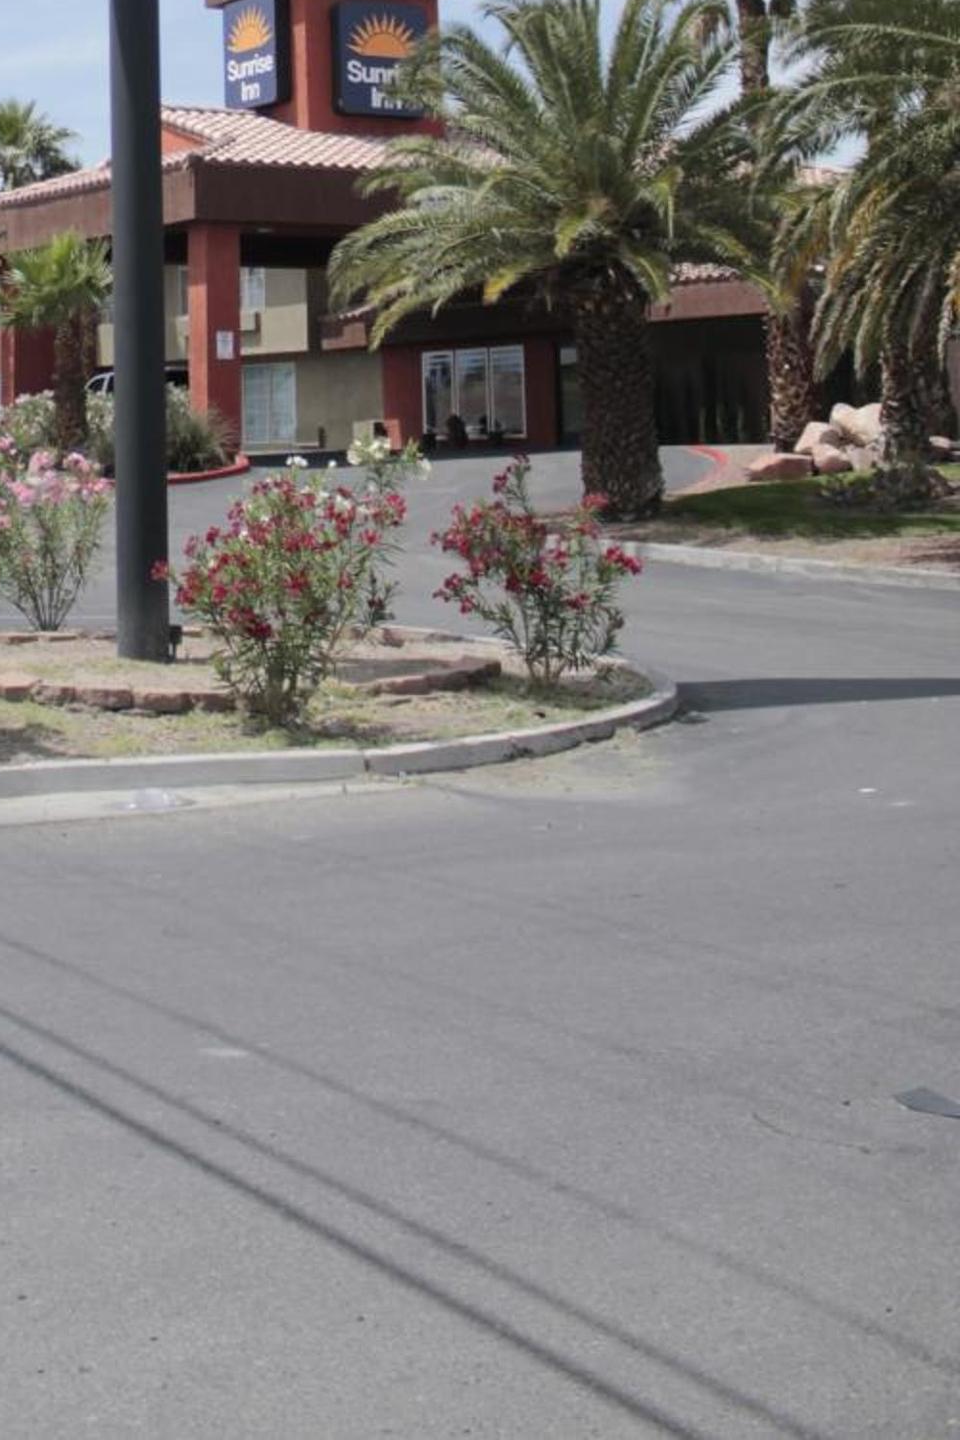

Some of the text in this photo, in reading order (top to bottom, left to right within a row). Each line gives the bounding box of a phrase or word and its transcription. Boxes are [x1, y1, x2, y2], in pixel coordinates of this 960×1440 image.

[228, 53, 273, 81] Sunrise
[347, 60, 401, 86] Sunri
[241, 80, 260, 101] Inn
